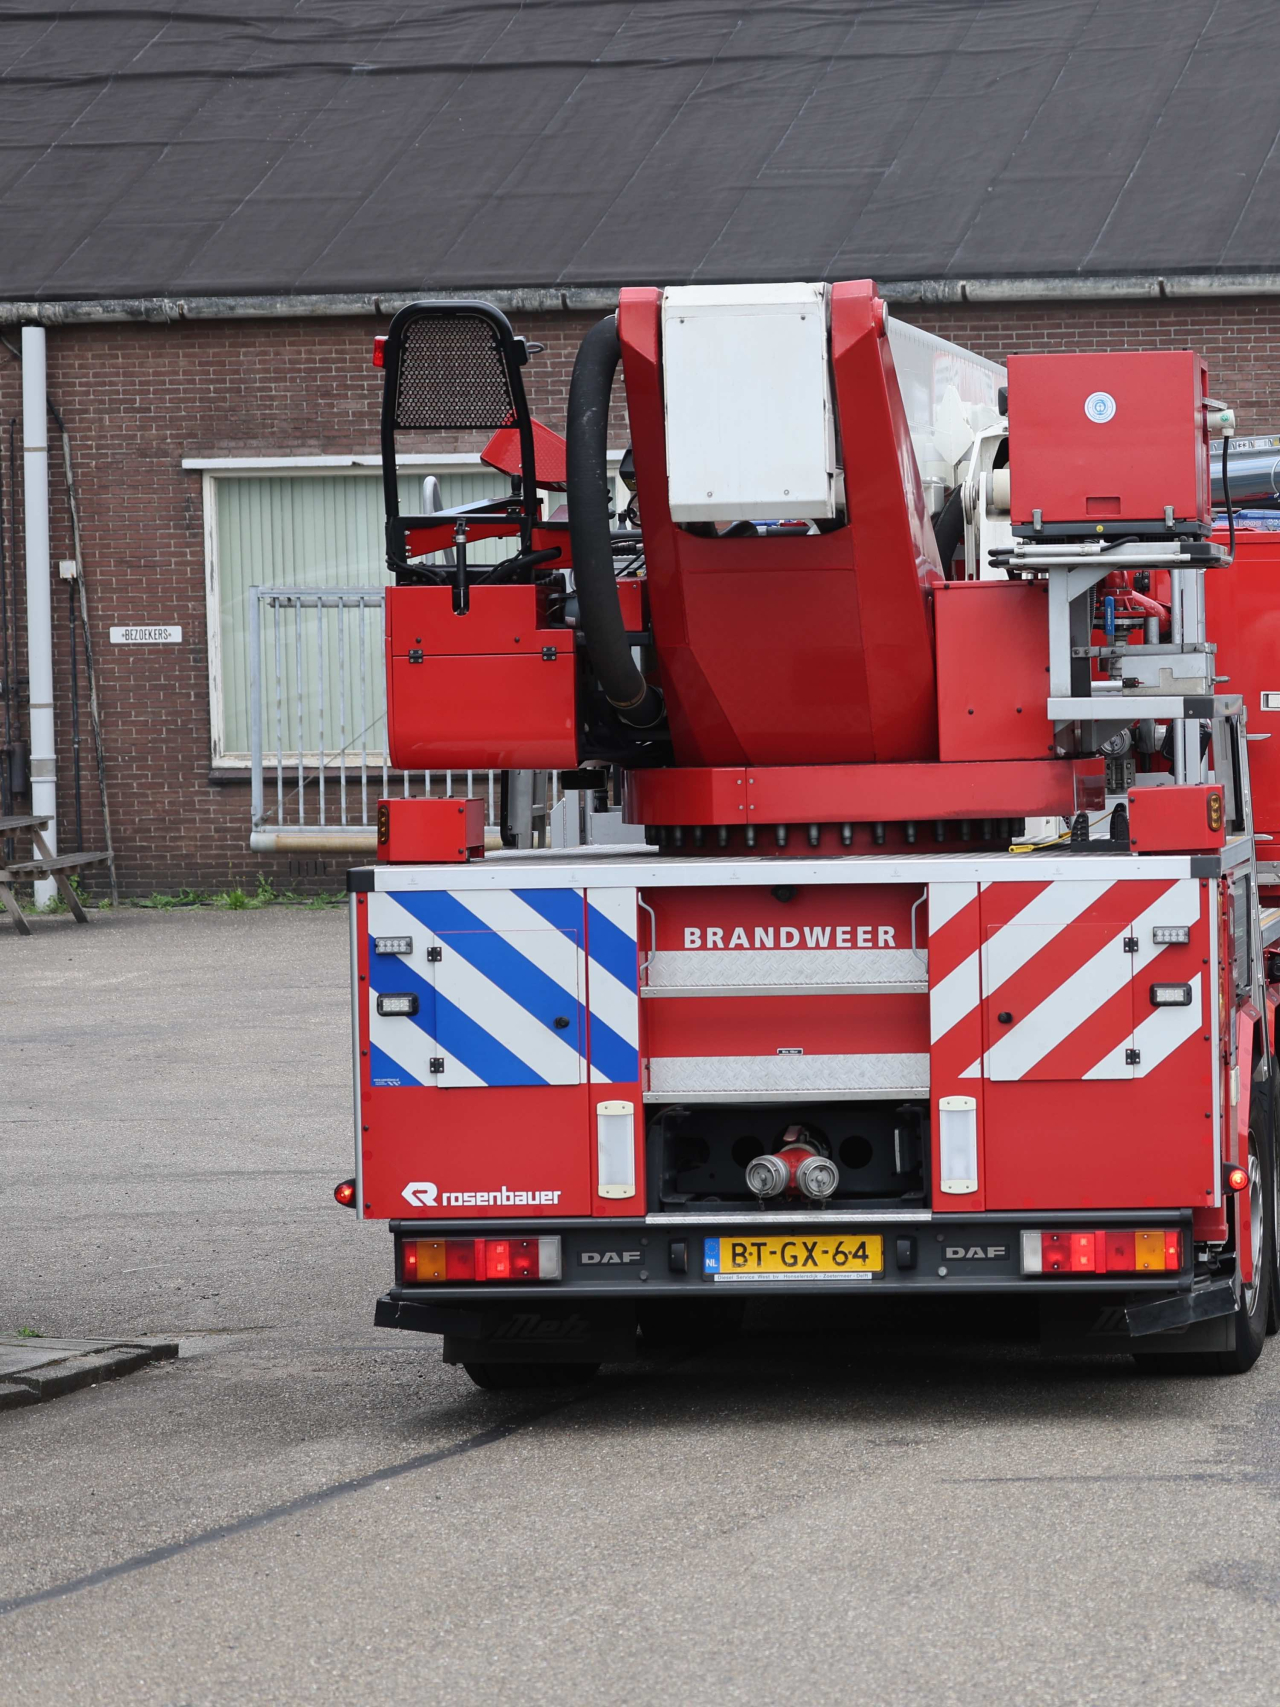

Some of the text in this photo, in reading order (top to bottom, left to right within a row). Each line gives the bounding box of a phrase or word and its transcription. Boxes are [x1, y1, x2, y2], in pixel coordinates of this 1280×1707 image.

[125, 629, 169, 641] BEZOEKERS
[684, 926, 896, 949] BRANDWEER
[442, 1185, 562, 1207] rosenbauer
[581, 1251, 641, 1264] DAF
[731, 1240, 870, 1269] BT-GX-64
[945, 1246, 1006, 1259] DAF
[705, 1258, 718, 1268] NL
